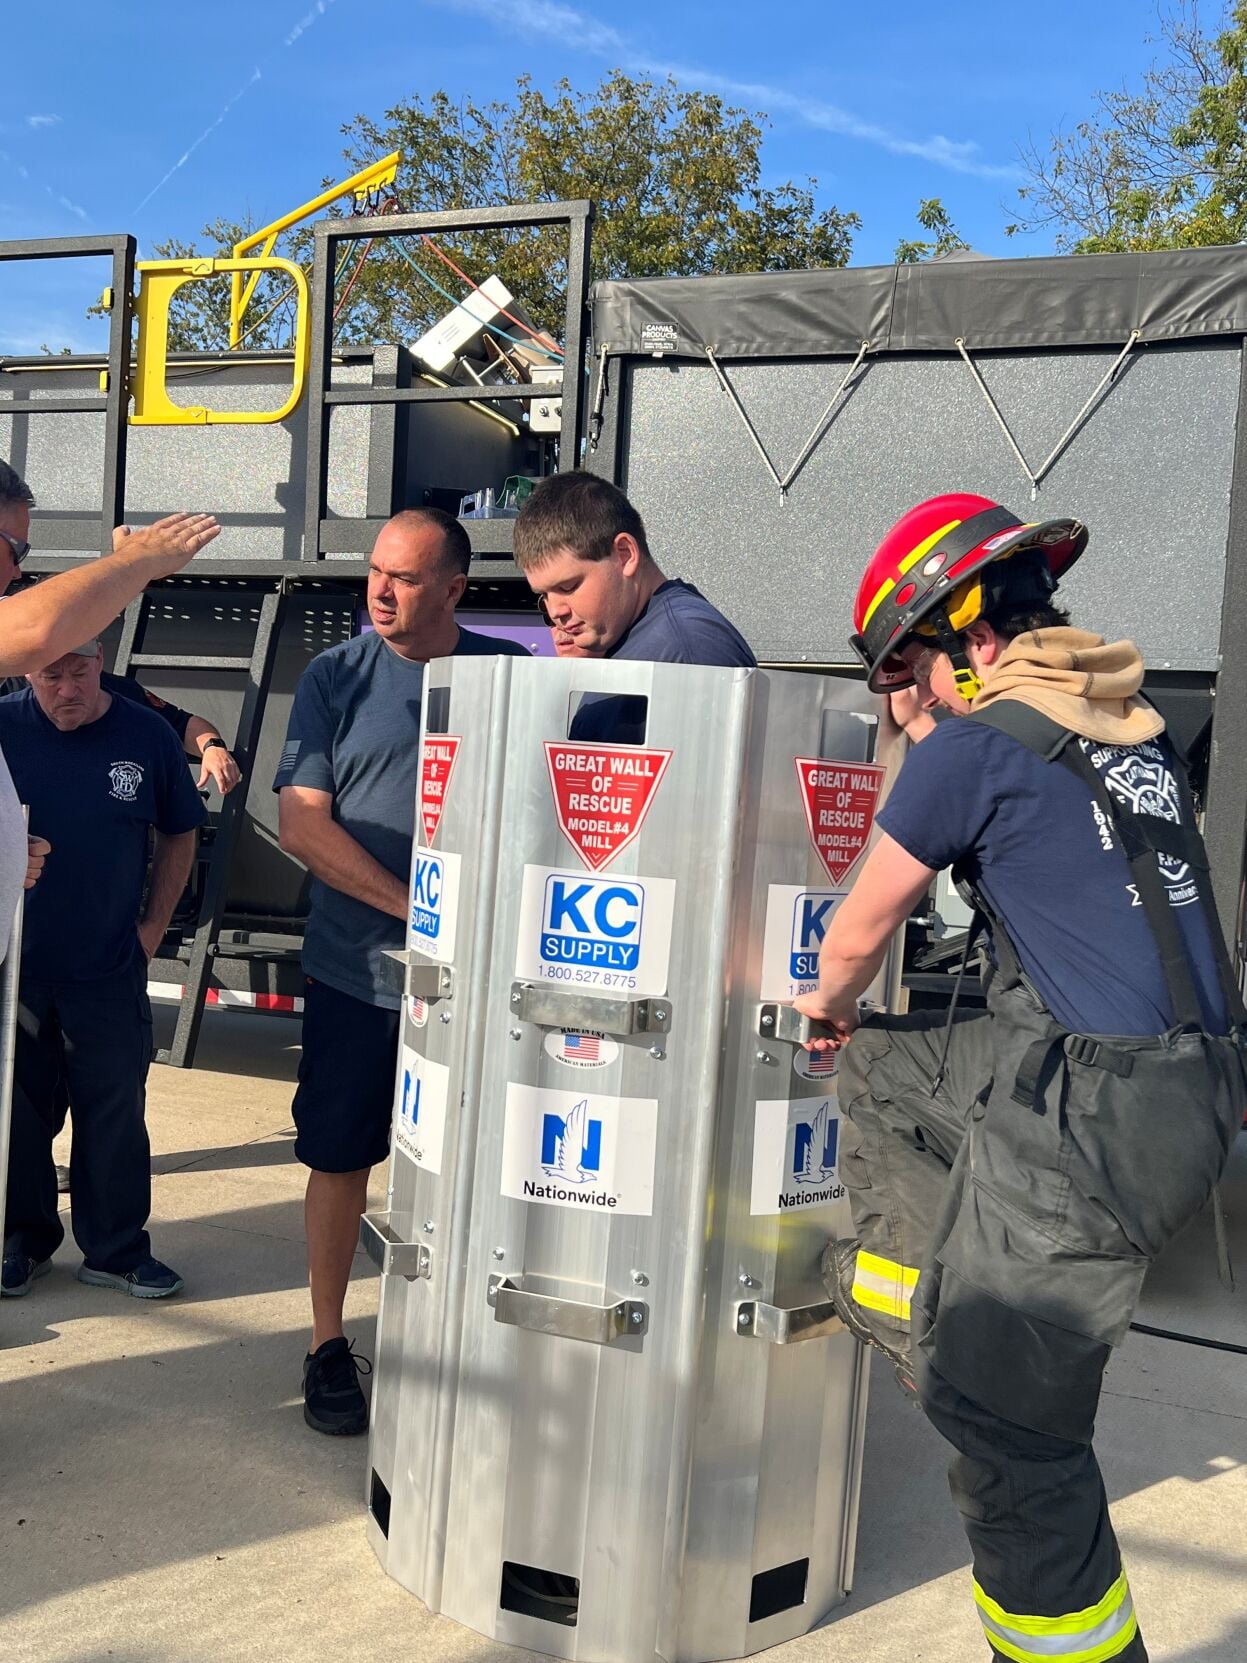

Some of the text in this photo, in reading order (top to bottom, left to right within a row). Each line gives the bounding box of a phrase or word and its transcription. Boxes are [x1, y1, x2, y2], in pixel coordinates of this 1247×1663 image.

[642, 331, 677, 339] PRODUCTS
[646, 325, 673, 333] CANVAS
[555, 753, 653, 777] GREAT WALL
[591, 775, 613, 793] OF
[807, 769, 879, 792] GREAT WALL
[568, 793, 633, 814] RESCUE
[836, 791, 852, 808] OF
[567, 817, 630, 835] MODEL#4
[819, 810, 865, 829] RESCUE
[1090, 800, 1114, 850] 1942
[581, 834, 613, 849] MILL
[818, 833, 862, 849] MODEL#4
[827, 849, 850, 862] MILL
[414, 858, 441, 909] KC
[549, 881, 639, 938] KC
[411, 910, 438, 933] SUPPLY
[800, 899, 835, 948] K
[545, 937, 634, 966] SUPPLY
[538, 965, 636, 988] 1.800.527.8775
[560, 1026, 580, 1035] MADE
[591, 1030, 605, 1040] USA
[555, 1054, 579, 1067] AMERICAN
[523, 1180, 617, 1208] Nationwide
[778, 1184, 845, 1208] Nationwide
